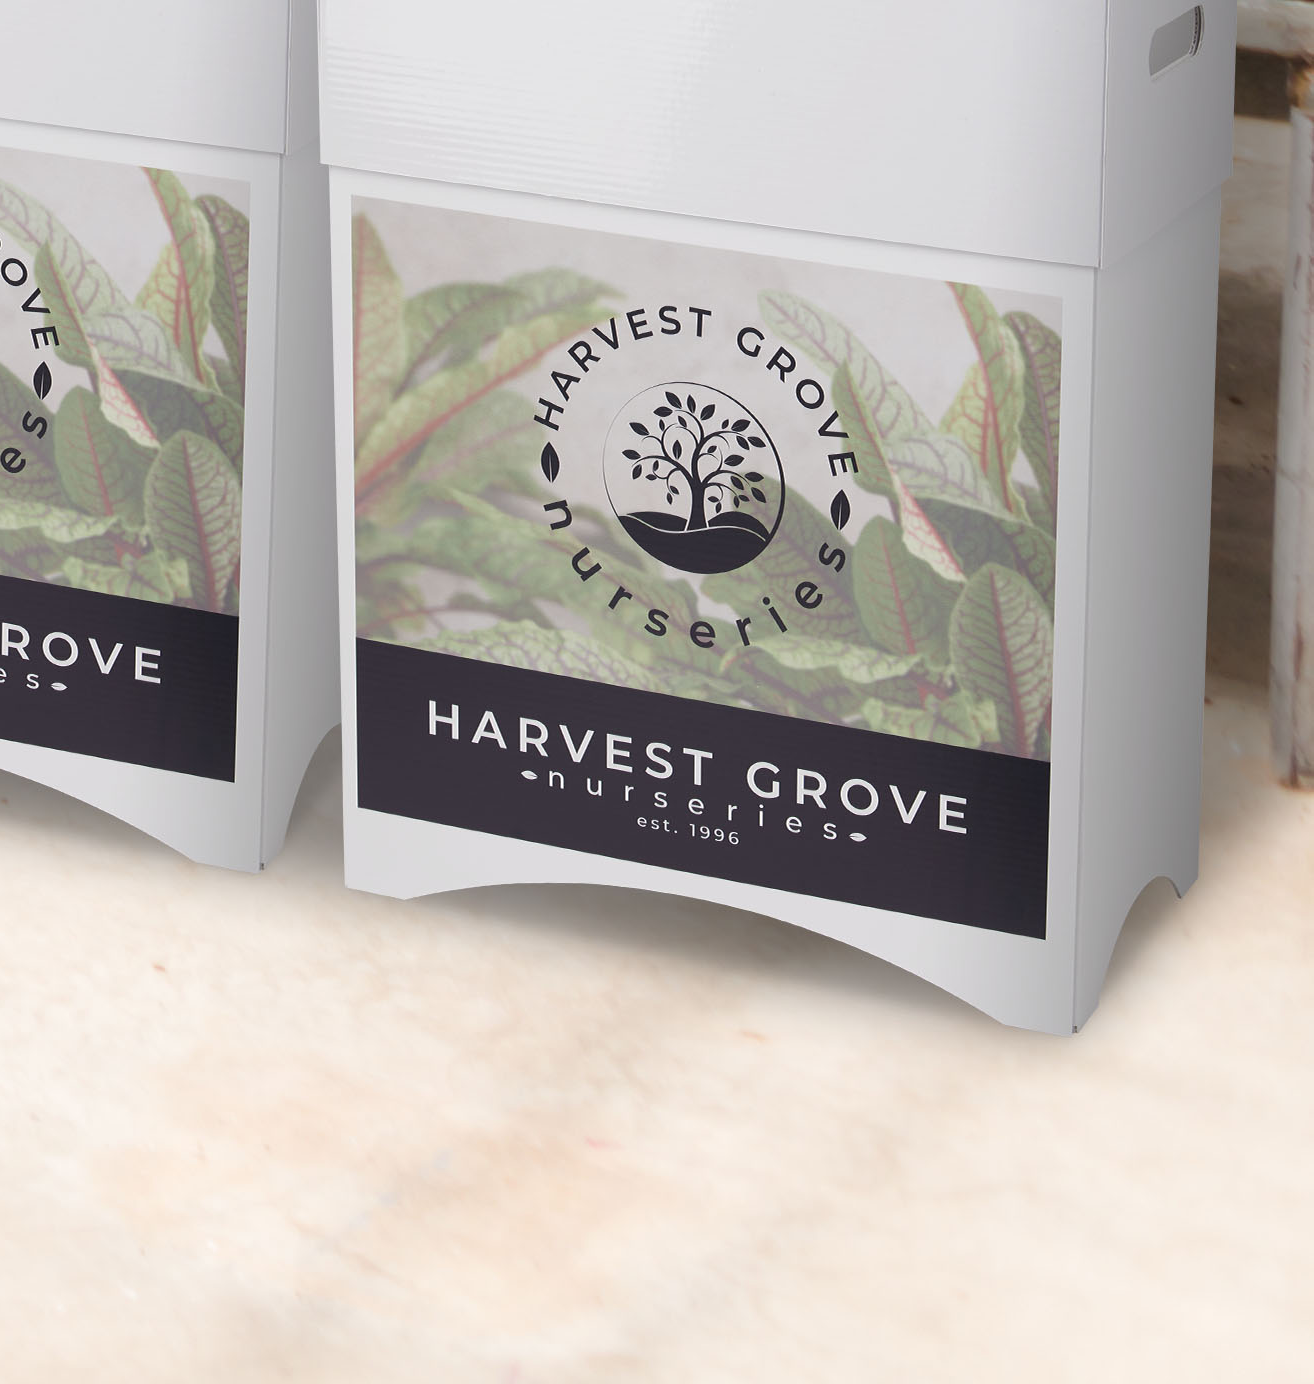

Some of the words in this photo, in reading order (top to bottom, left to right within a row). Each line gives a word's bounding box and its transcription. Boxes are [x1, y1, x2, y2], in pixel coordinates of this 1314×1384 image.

[533, 305, 712, 431] HARVEST
[737, 326, 859, 477] GROVE
[543, 499, 846, 649] nurseries
[428, 699, 713, 786] HARVEST
[746, 761, 967, 835] GROVE
[548, 770, 838, 840] nurseries
[636, 815, 678, 835] est.
[689, 823, 740, 846] 1996
